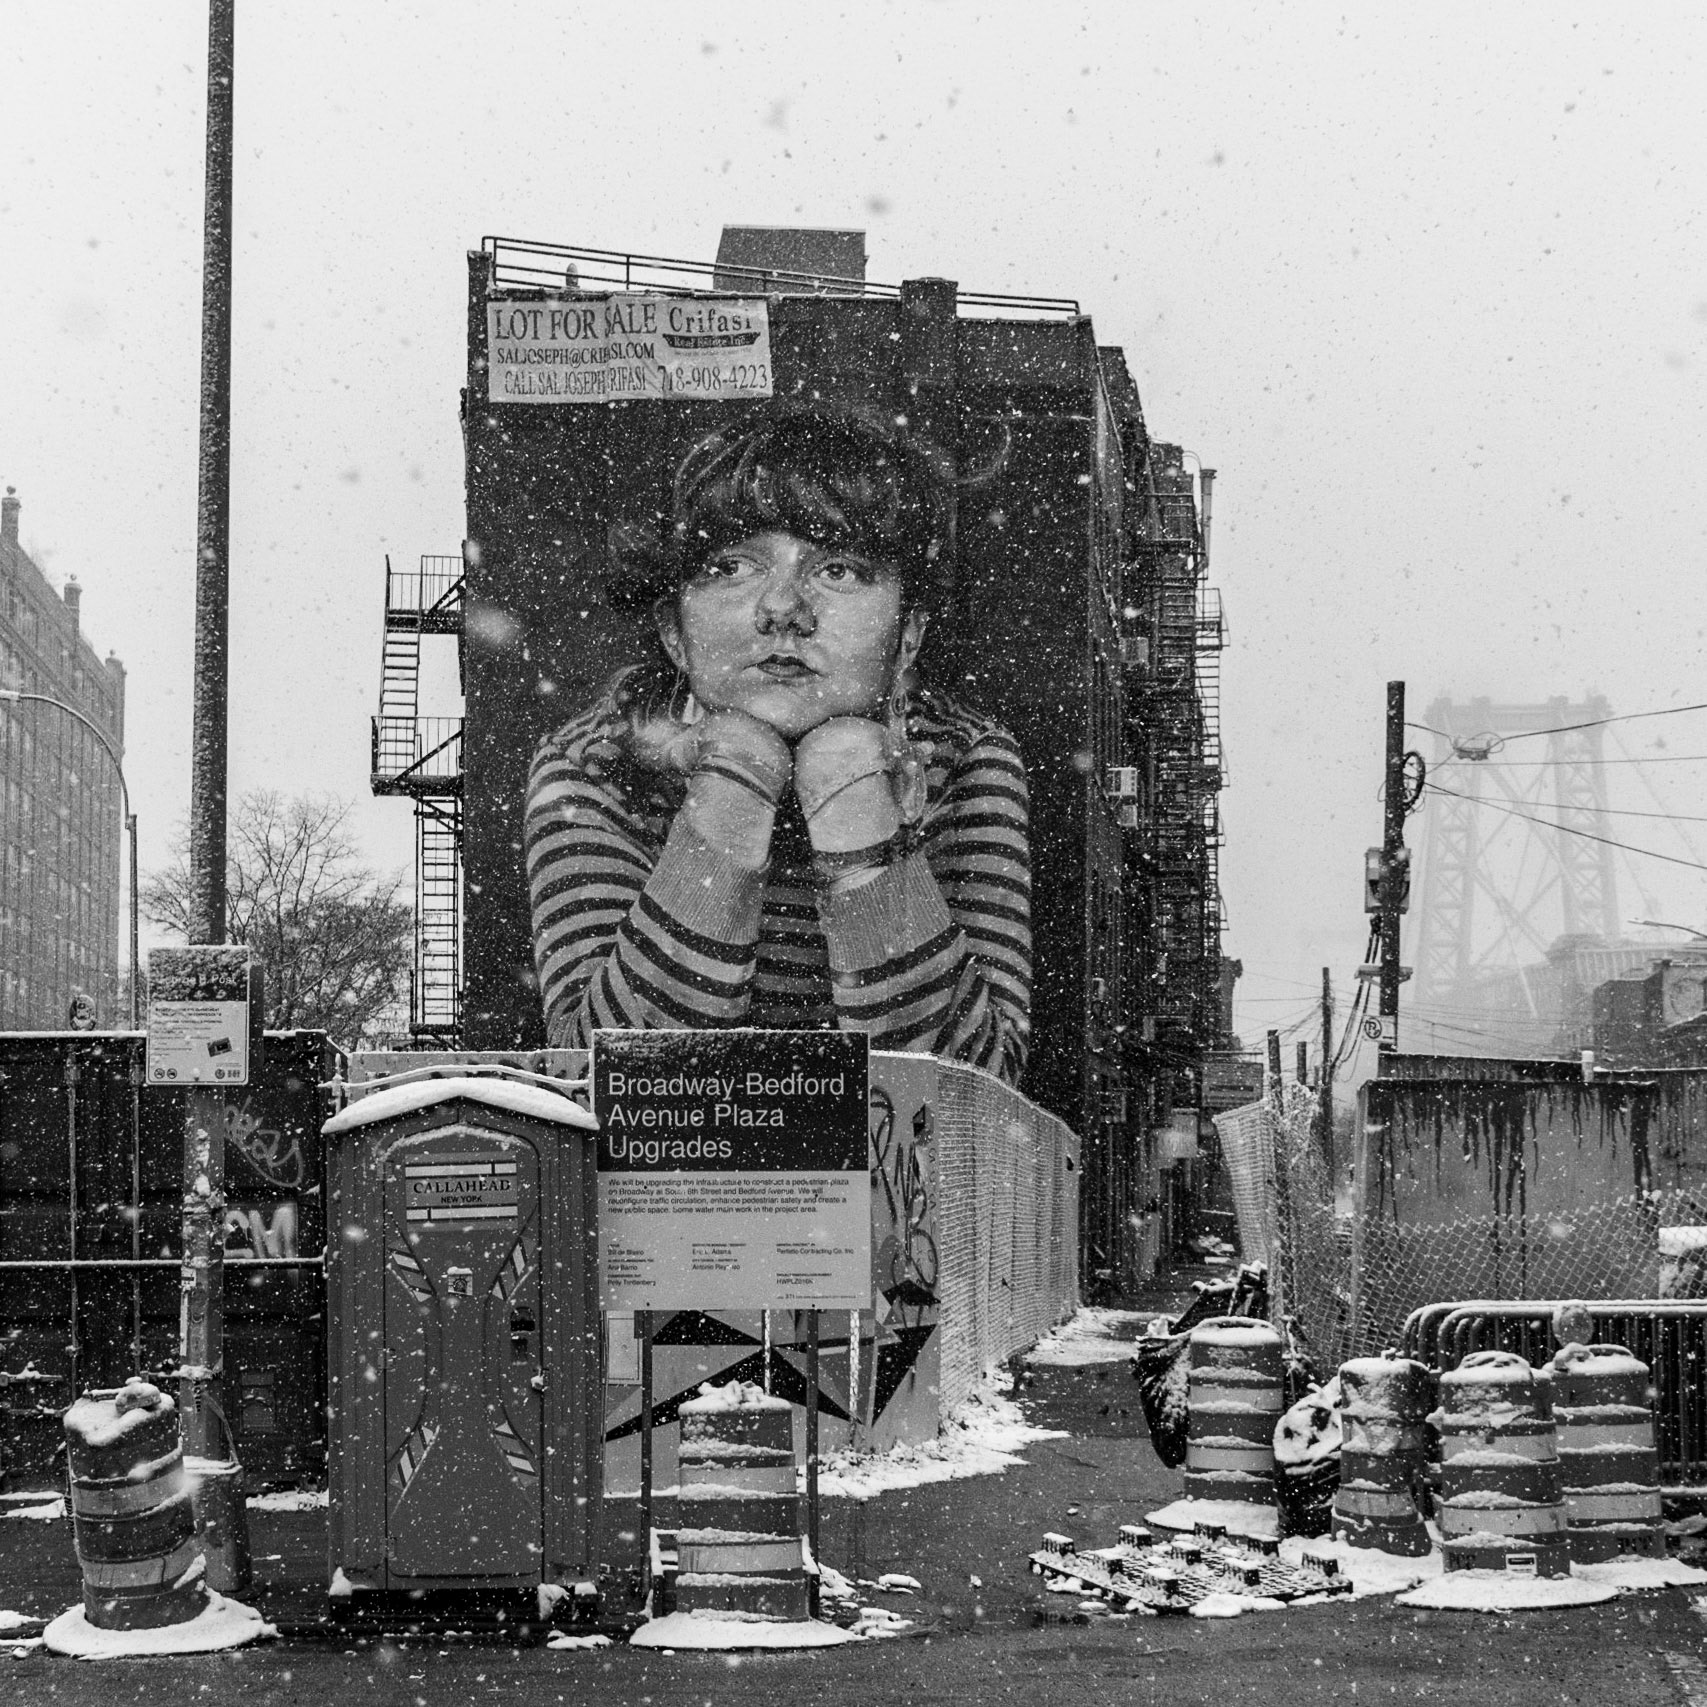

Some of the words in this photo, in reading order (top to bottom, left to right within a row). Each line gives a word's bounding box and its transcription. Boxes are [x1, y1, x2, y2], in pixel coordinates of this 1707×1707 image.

[495, 309, 543, 340] LOT
[549, 309, 598, 340] FOR
[604, 303, 658, 338] SALE
[669, 306, 752, 333] Crifasi
[505, 371, 536, 395] CALL
[538, 370, 561, 395] SAL
[565, 370, 605, 395] JOSEPH
[608, 1072, 845, 1101] Broadway-Bedford
[608, 1104, 705, 1127] Avenue
[715, 1104, 785, 1127] Plaza
[609, 1135, 733, 1164] Upgrades
[413, 1179, 511, 1194] CALLAHEAD
[619, 1188, 654, 1197] Broadway
[646, 1179, 681, 1187] upgrading
[830, 1179, 849, 1187] plaza
[441, 1196, 459, 1204] NEW
[460, 1195, 482, 1203] YORK
[608, 1197, 648, 1205] reconfigure
[671, 1197, 709, 1205] circulation,
[742, 1197, 779, 1205] pedestrian
[780, 1197, 801, 1205] safety
[624, 1206, 646, 1215] public
[774, 1206, 799, 1215] project
